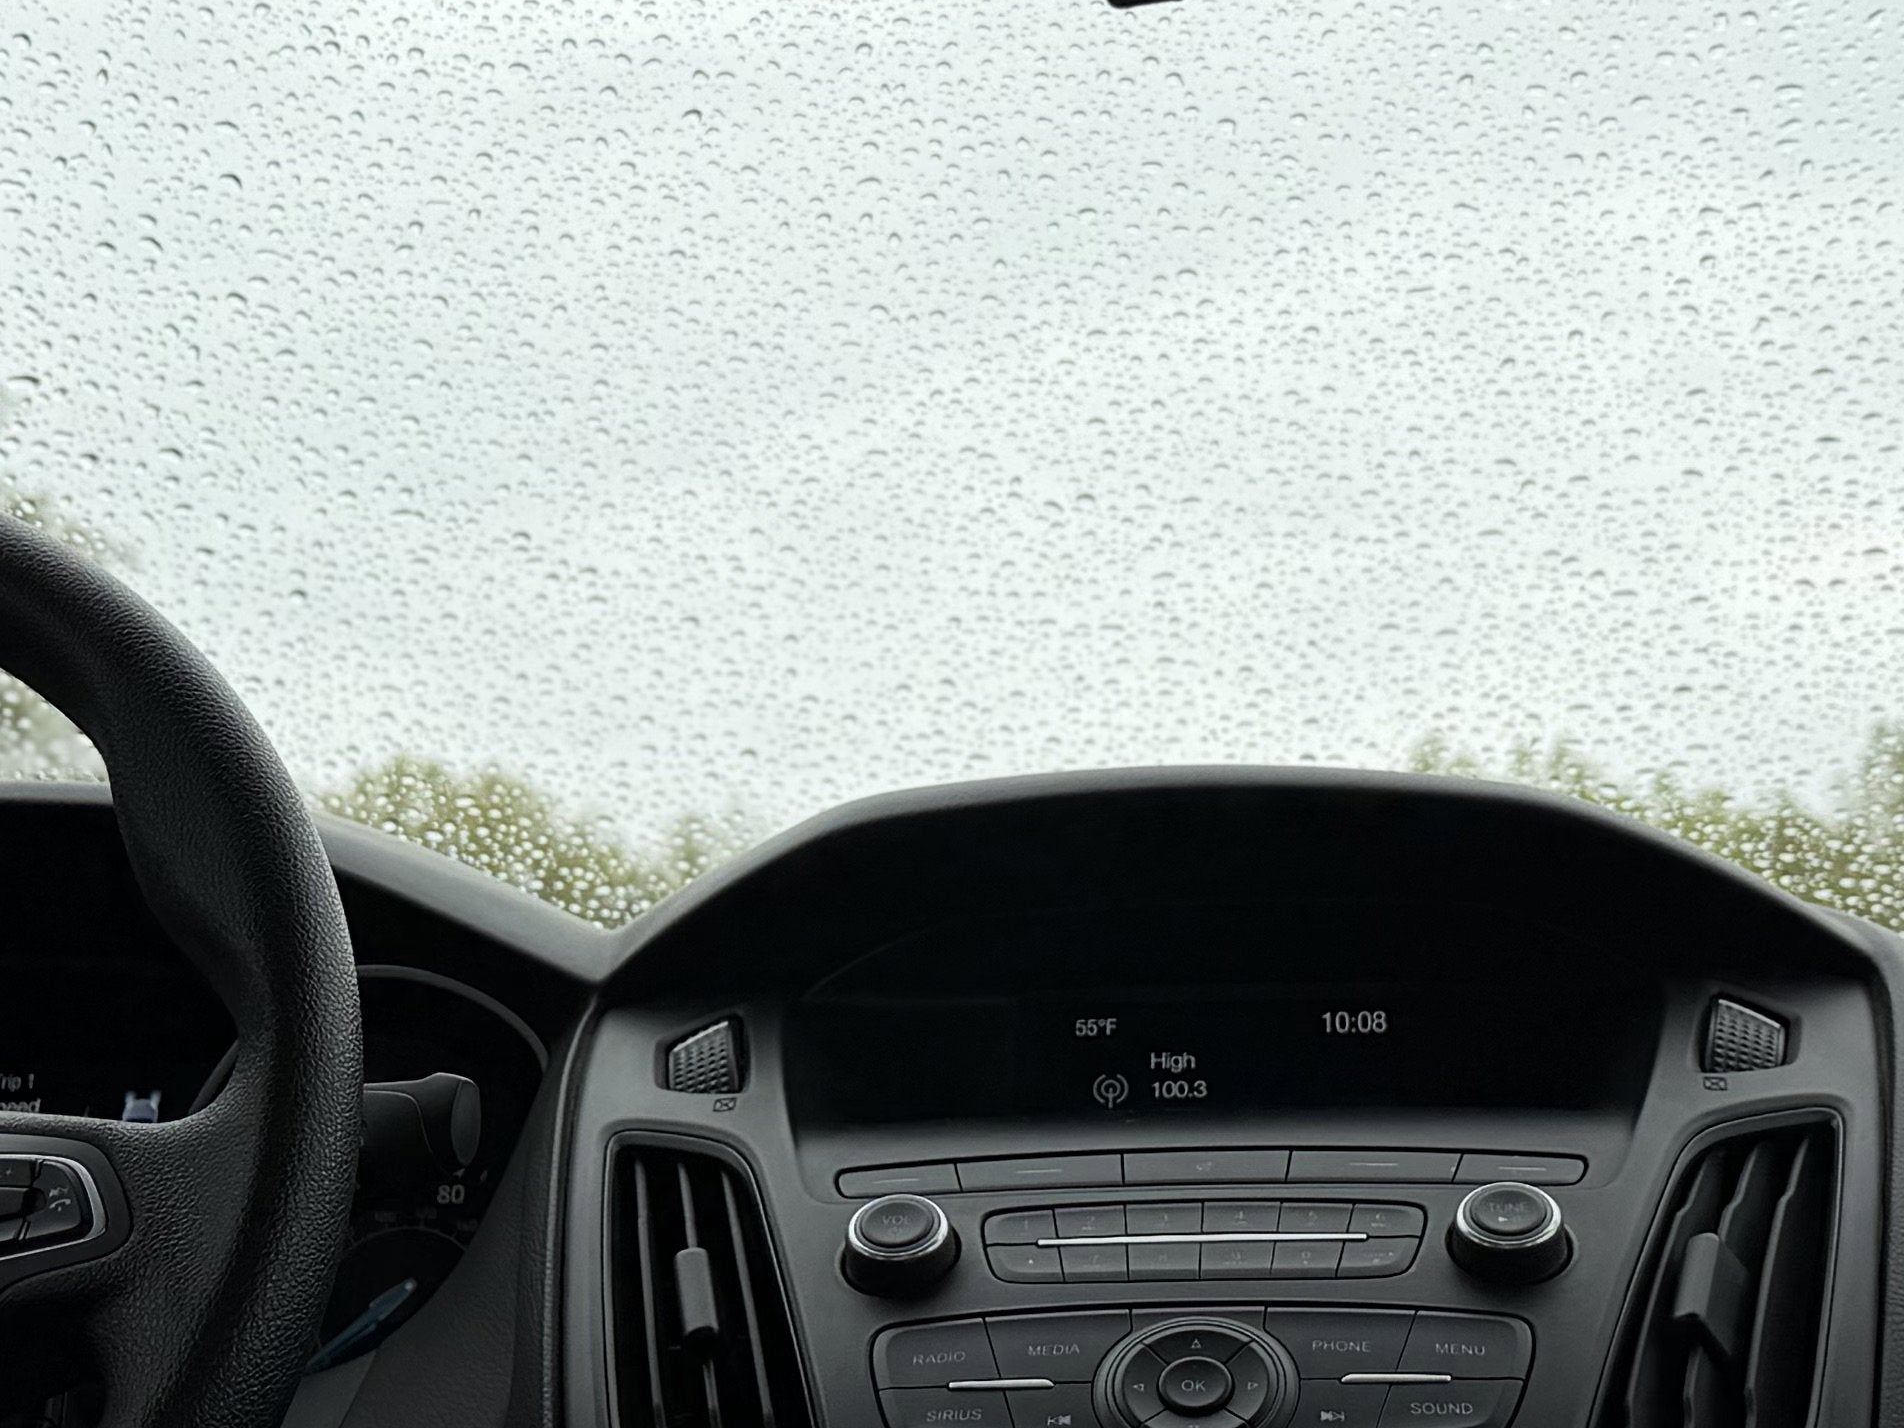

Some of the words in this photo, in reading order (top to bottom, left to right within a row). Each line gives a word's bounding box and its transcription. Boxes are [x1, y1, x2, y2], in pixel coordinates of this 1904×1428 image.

[1074, 1017, 1118, 1037] 55°F
[1321, 1010, 1388, 1035] 10:08
[1149, 1051, 1197, 1073] High
[1151, 1080, 1208, 1100] 100.3
[436, 1184, 465, 1205] 80
[1026, 1341, 1081, 1357] MEDIA
[1310, 1338, 1372, 1354] PHONE
[1433, 1341, 1487, 1357] MENU
[911, 1350, 966, 1366] RADIO
[1180, 1377, 1206, 1393] OK
[925, 1407, 983, 1424] SIRIUS
[1409, 1400, 1474, 1417] SOUND
